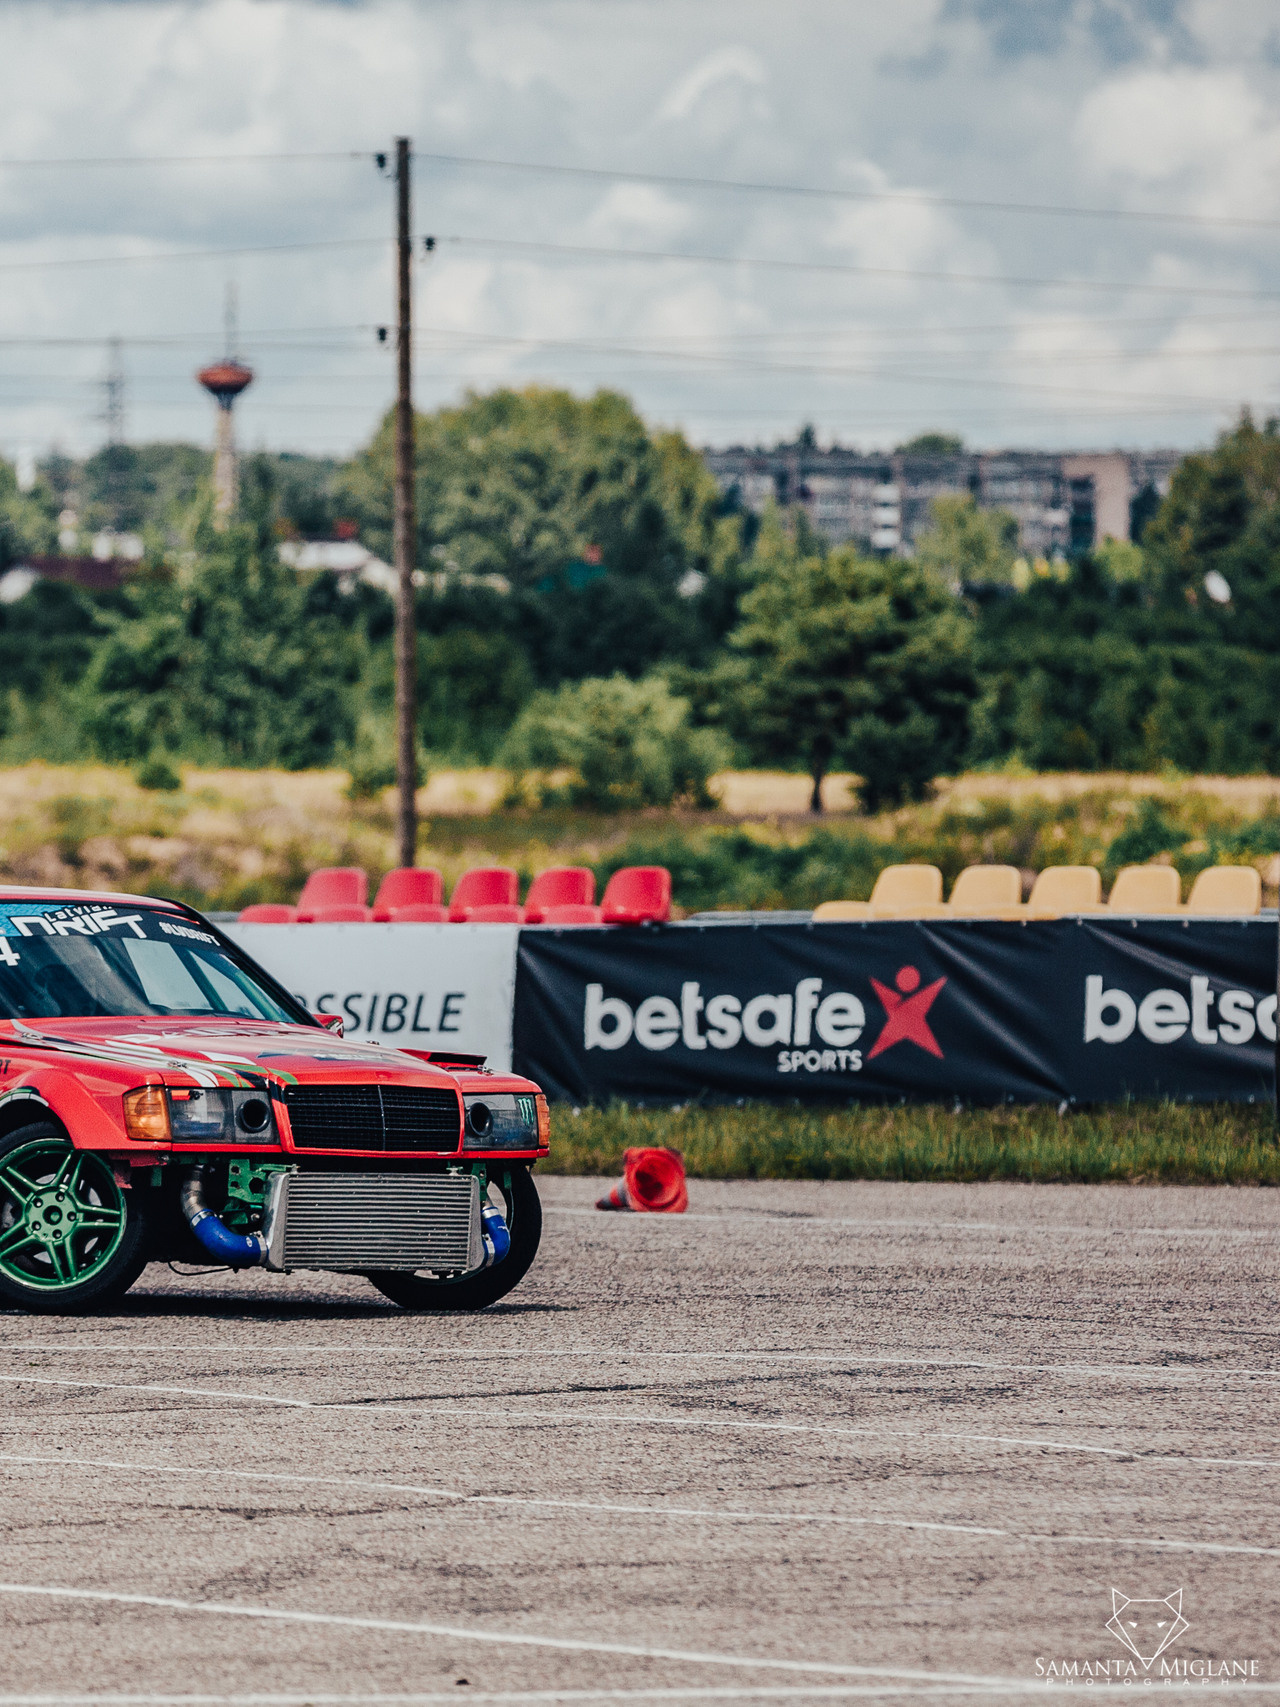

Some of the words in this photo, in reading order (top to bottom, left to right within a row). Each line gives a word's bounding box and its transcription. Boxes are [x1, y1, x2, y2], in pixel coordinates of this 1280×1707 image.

[9, 909, 148, 939] DRIFT
[584, 978, 865, 1051] betsafe
[777, 1050, 863, 1072] SPORTS
